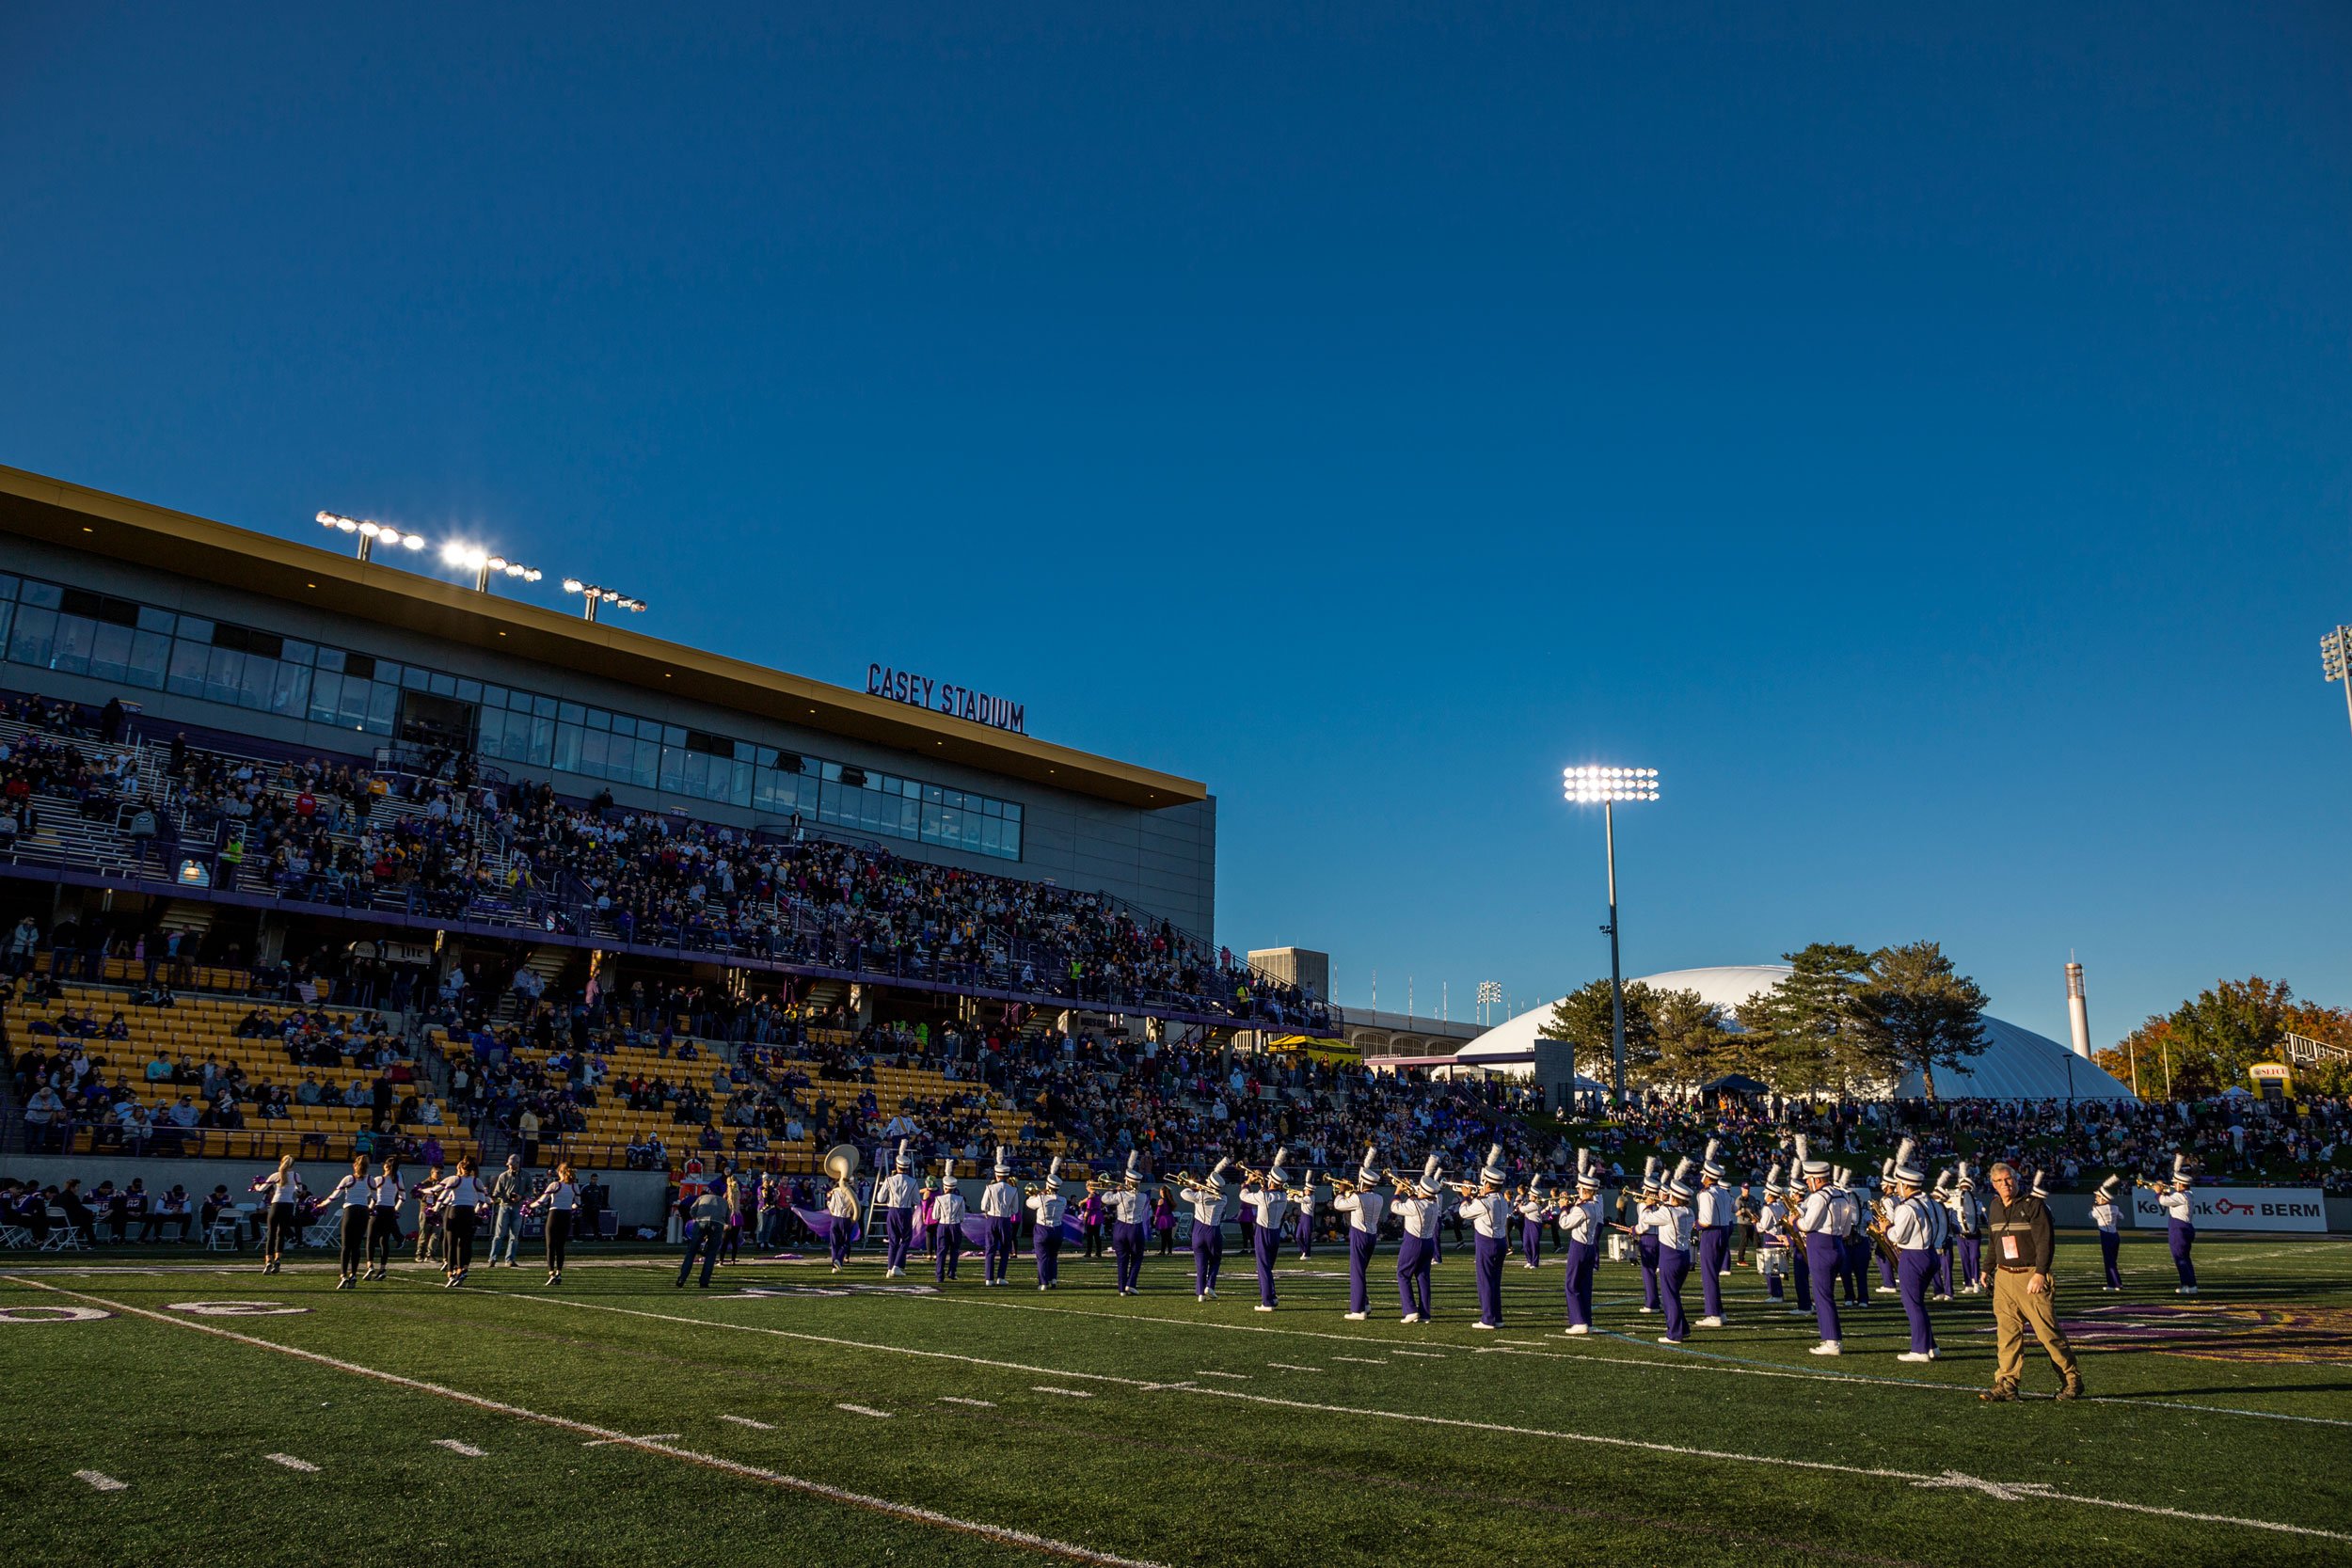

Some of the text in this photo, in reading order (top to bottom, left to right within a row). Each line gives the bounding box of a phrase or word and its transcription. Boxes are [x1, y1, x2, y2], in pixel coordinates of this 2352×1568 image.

[866, 662, 1025, 733] CASEY STADIUM
[2137, 1200, 2321, 1217] Keynk BERM
